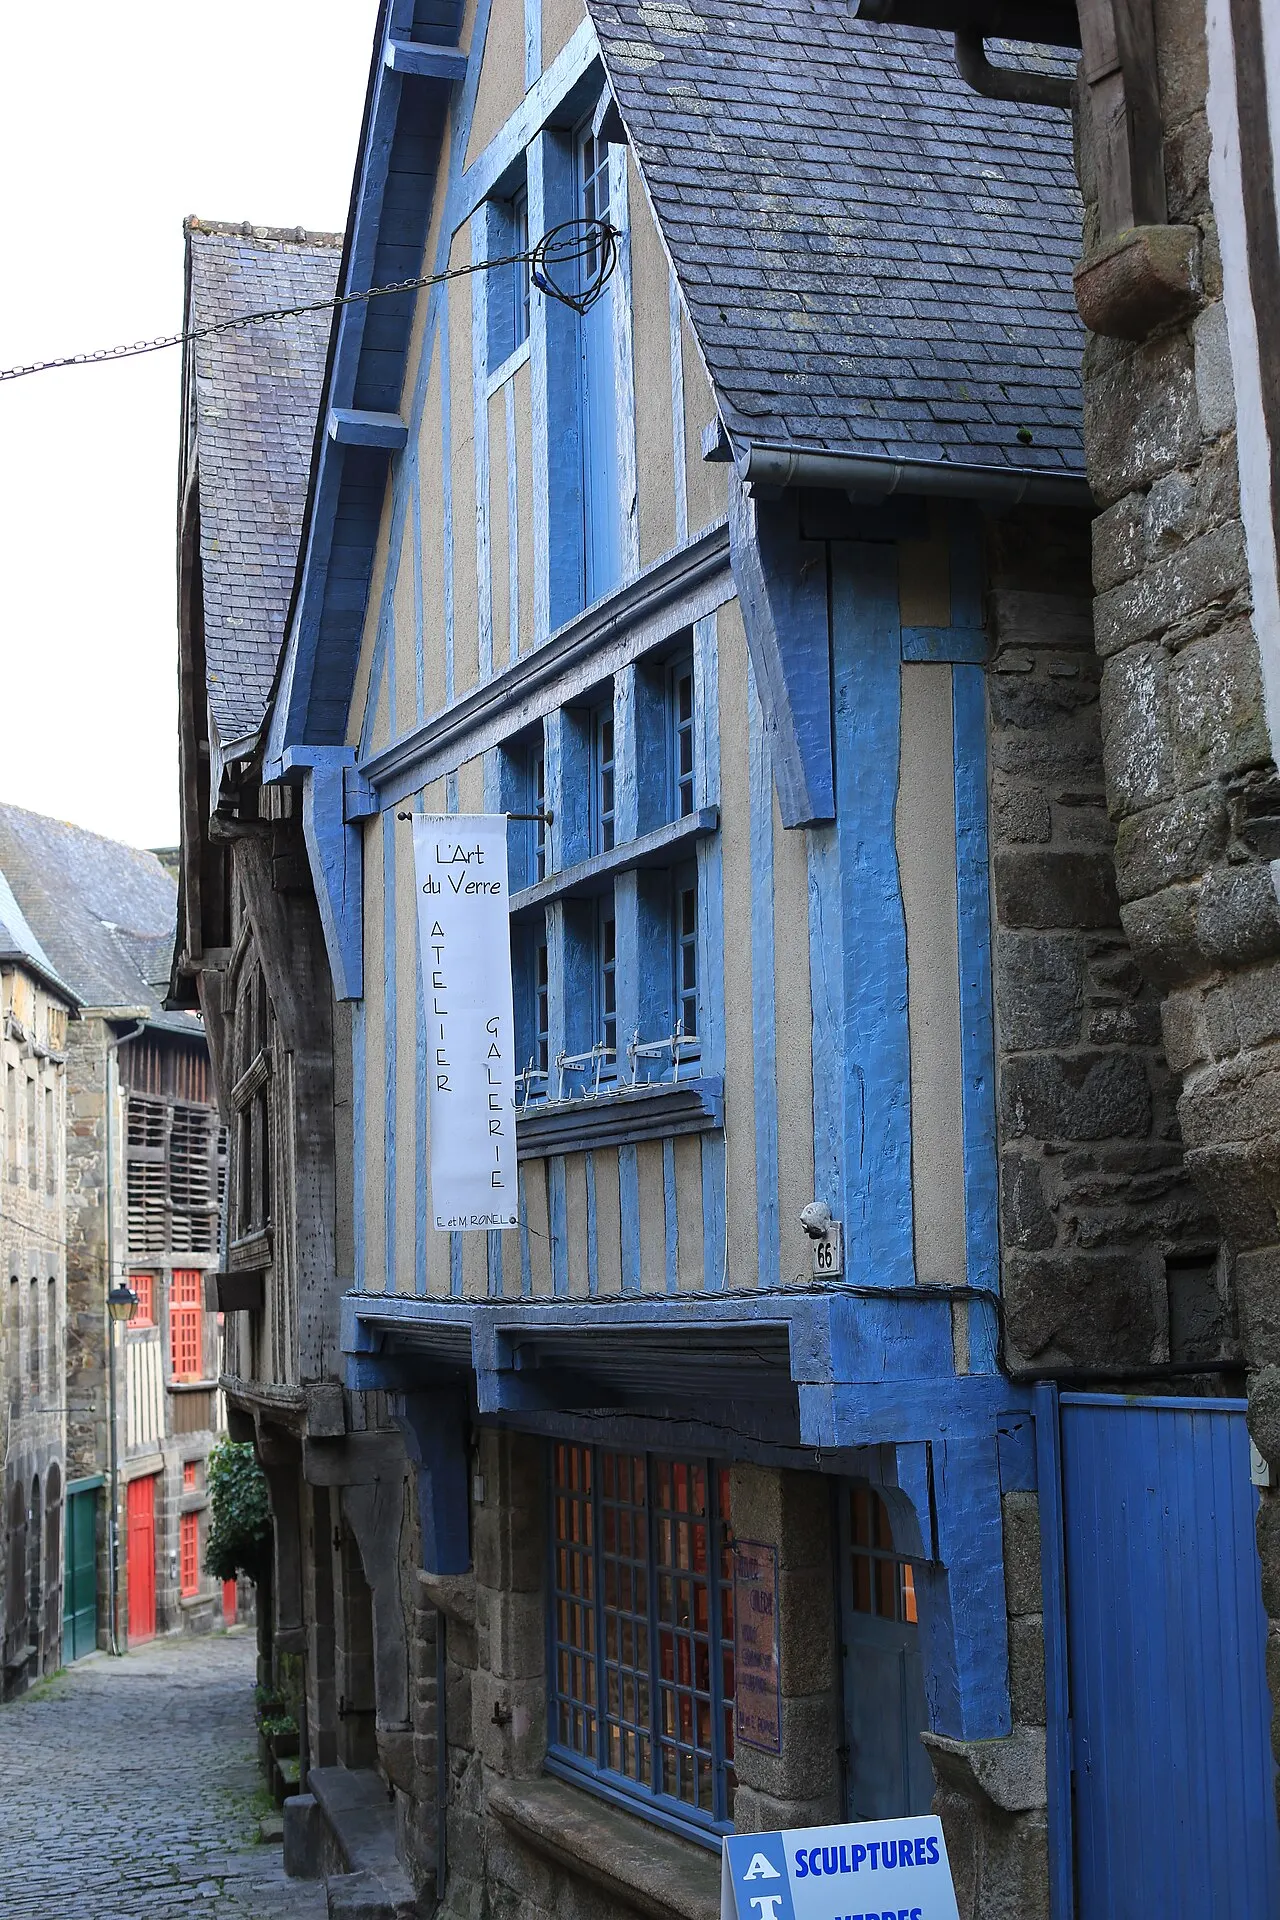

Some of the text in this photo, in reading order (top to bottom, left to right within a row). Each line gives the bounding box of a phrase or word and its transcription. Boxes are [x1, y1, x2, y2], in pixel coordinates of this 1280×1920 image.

[436, 844, 485, 864] L'Art
[422, 870, 501, 895] du Verre
[430, 920, 452, 1092] ATELIER
[485, 1016, 505, 1188] GALERIE
[447, 1216, 457, 1227] et
[817, 1242, 832, 1268] 66
[795, 1836, 940, 1878] SCULPTURES
